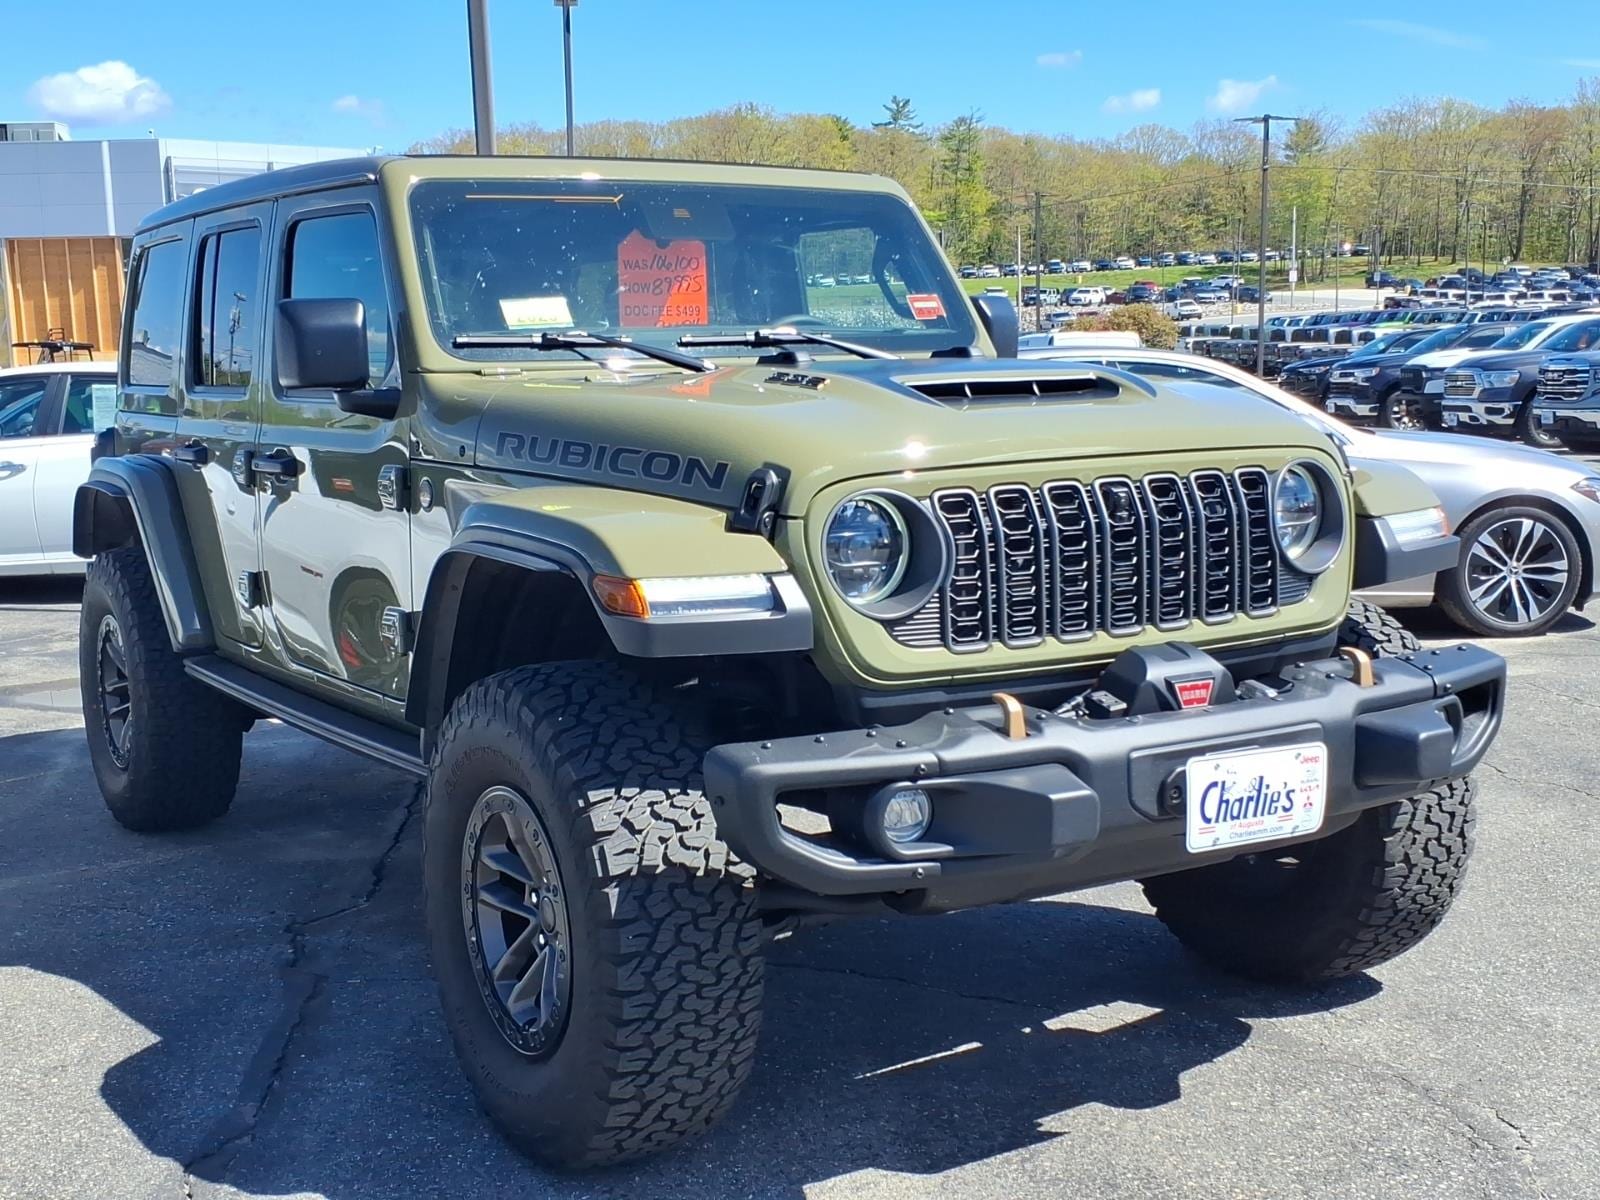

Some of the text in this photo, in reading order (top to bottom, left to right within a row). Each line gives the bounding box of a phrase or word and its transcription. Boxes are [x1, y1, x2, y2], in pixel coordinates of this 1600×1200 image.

[622, 259, 649, 271] WAS
[623, 282, 651, 294] NOW
[624, 305, 701, 317] DOC FEE $499
[495, 431, 732, 492] RUBICON
[1300, 754, 1321, 764] Jeep
[1199, 775, 1296, 824] Charlie's
